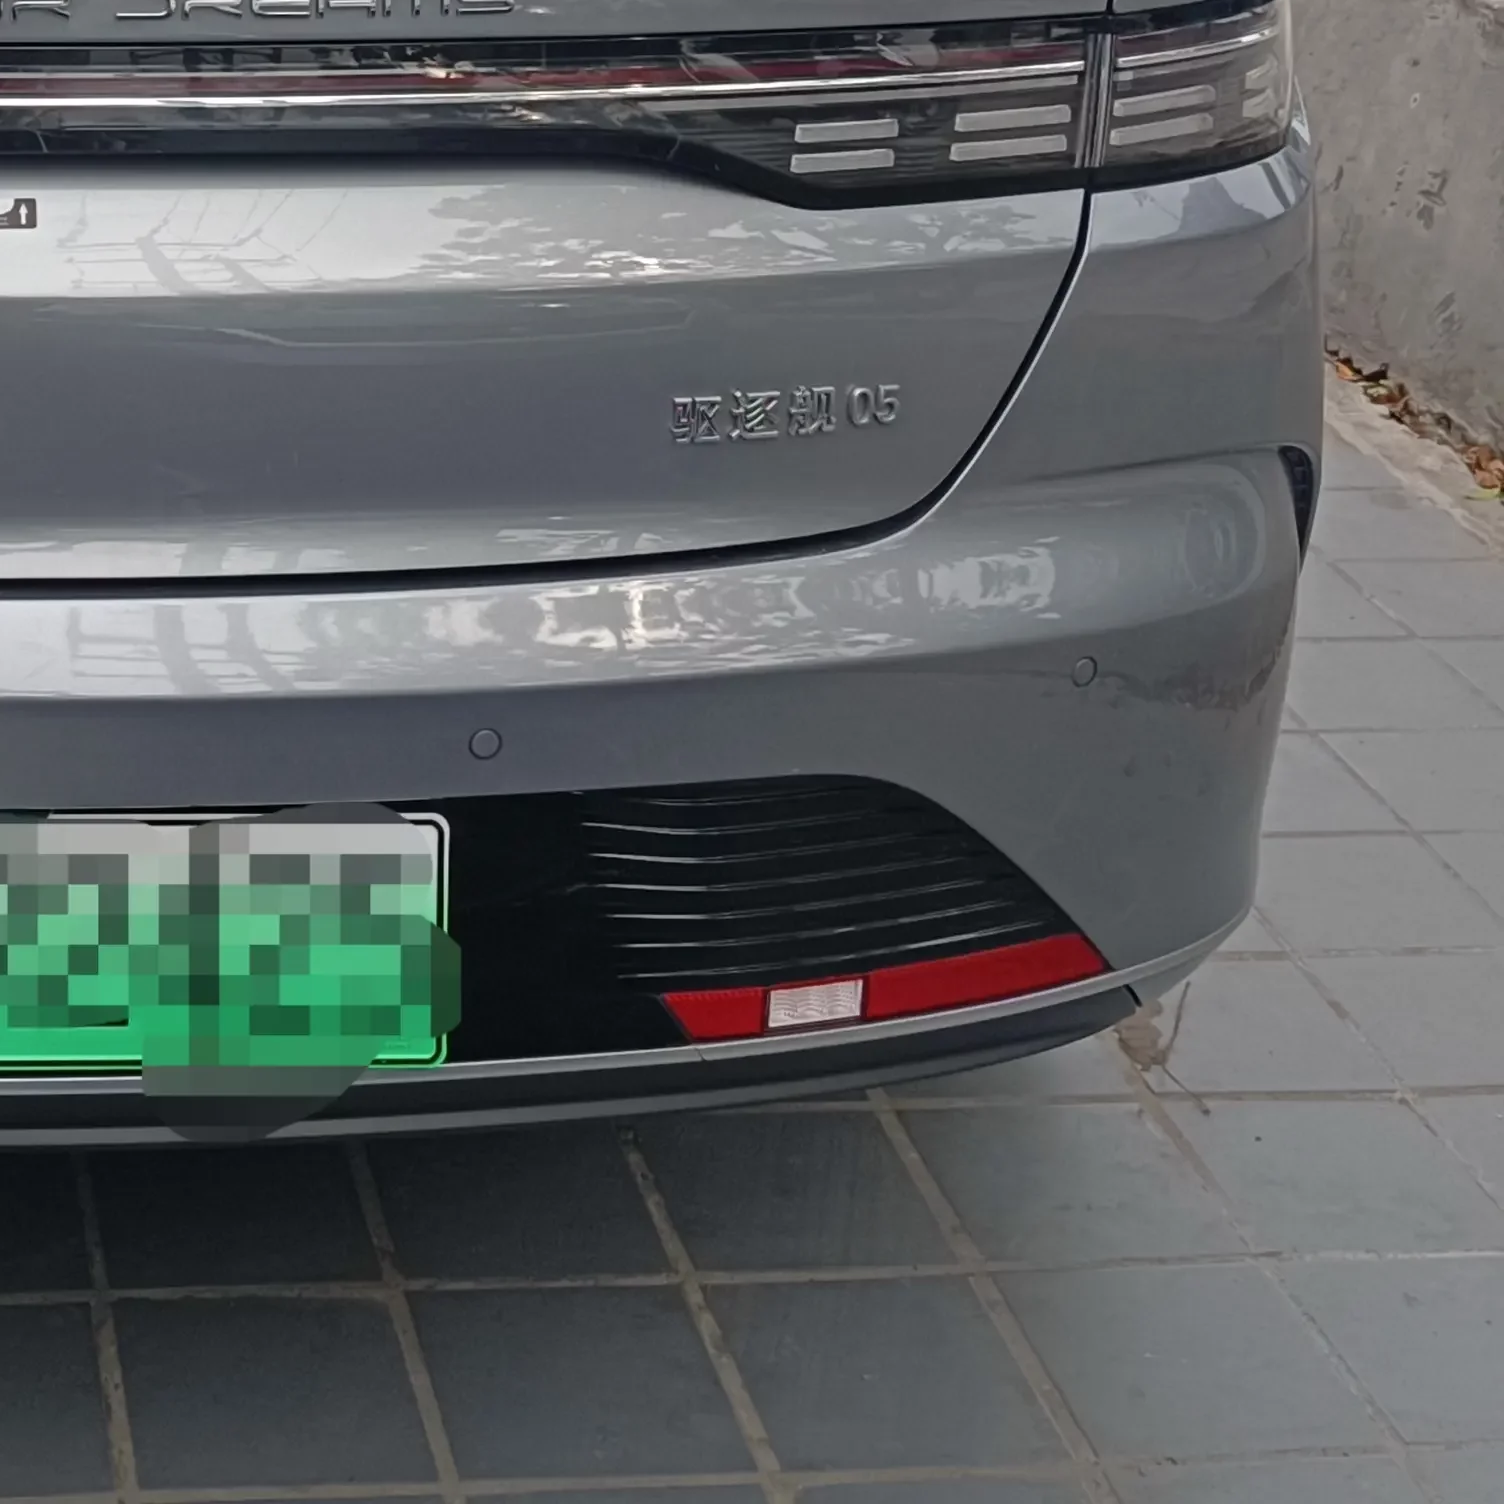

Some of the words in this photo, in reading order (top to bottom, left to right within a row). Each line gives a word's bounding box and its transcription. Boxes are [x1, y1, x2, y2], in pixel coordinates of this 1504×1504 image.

[670, 385, 837, 443] 驱逐舰
[847, 384, 901, 426] 05
